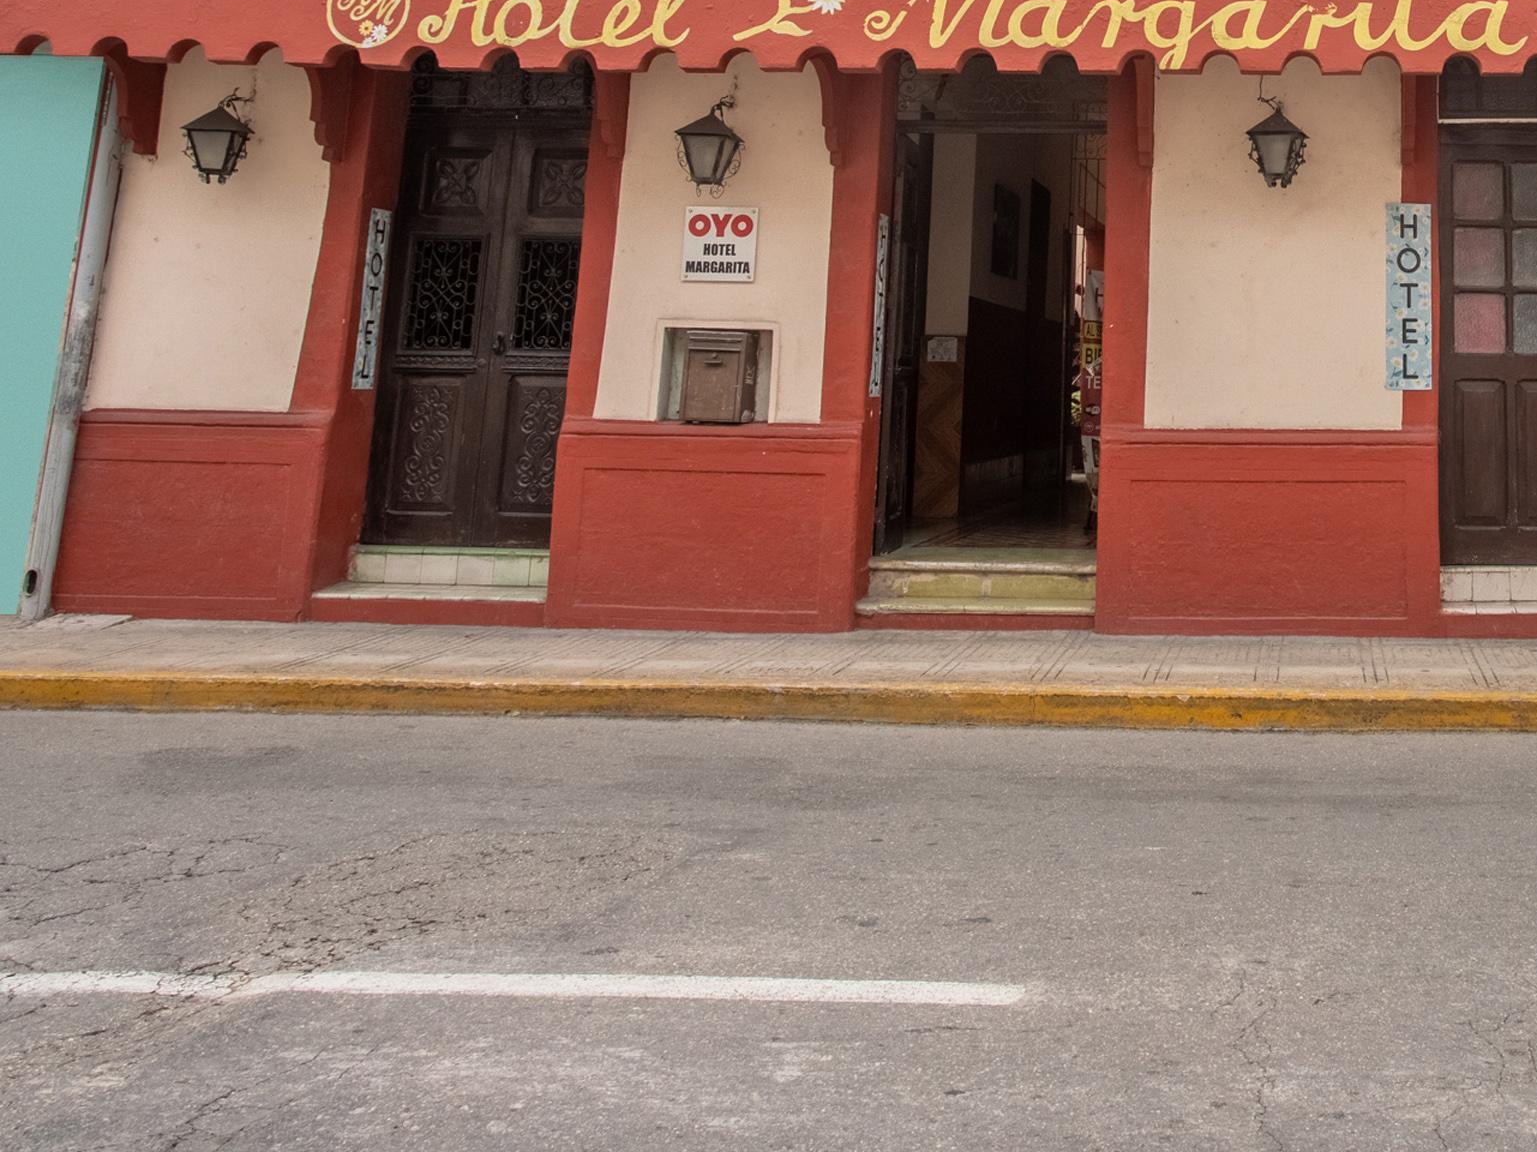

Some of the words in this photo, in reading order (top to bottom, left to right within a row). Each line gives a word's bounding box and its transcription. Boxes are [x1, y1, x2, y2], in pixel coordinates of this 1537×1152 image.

[688, 214, 754, 238] OYO
[703, 243, 737, 256] HOTEL
[685, 260, 751, 274] MARGARITA
[361, 219, 387, 380] HOTEL
[1396, 213, 1422, 381] HOTEL
